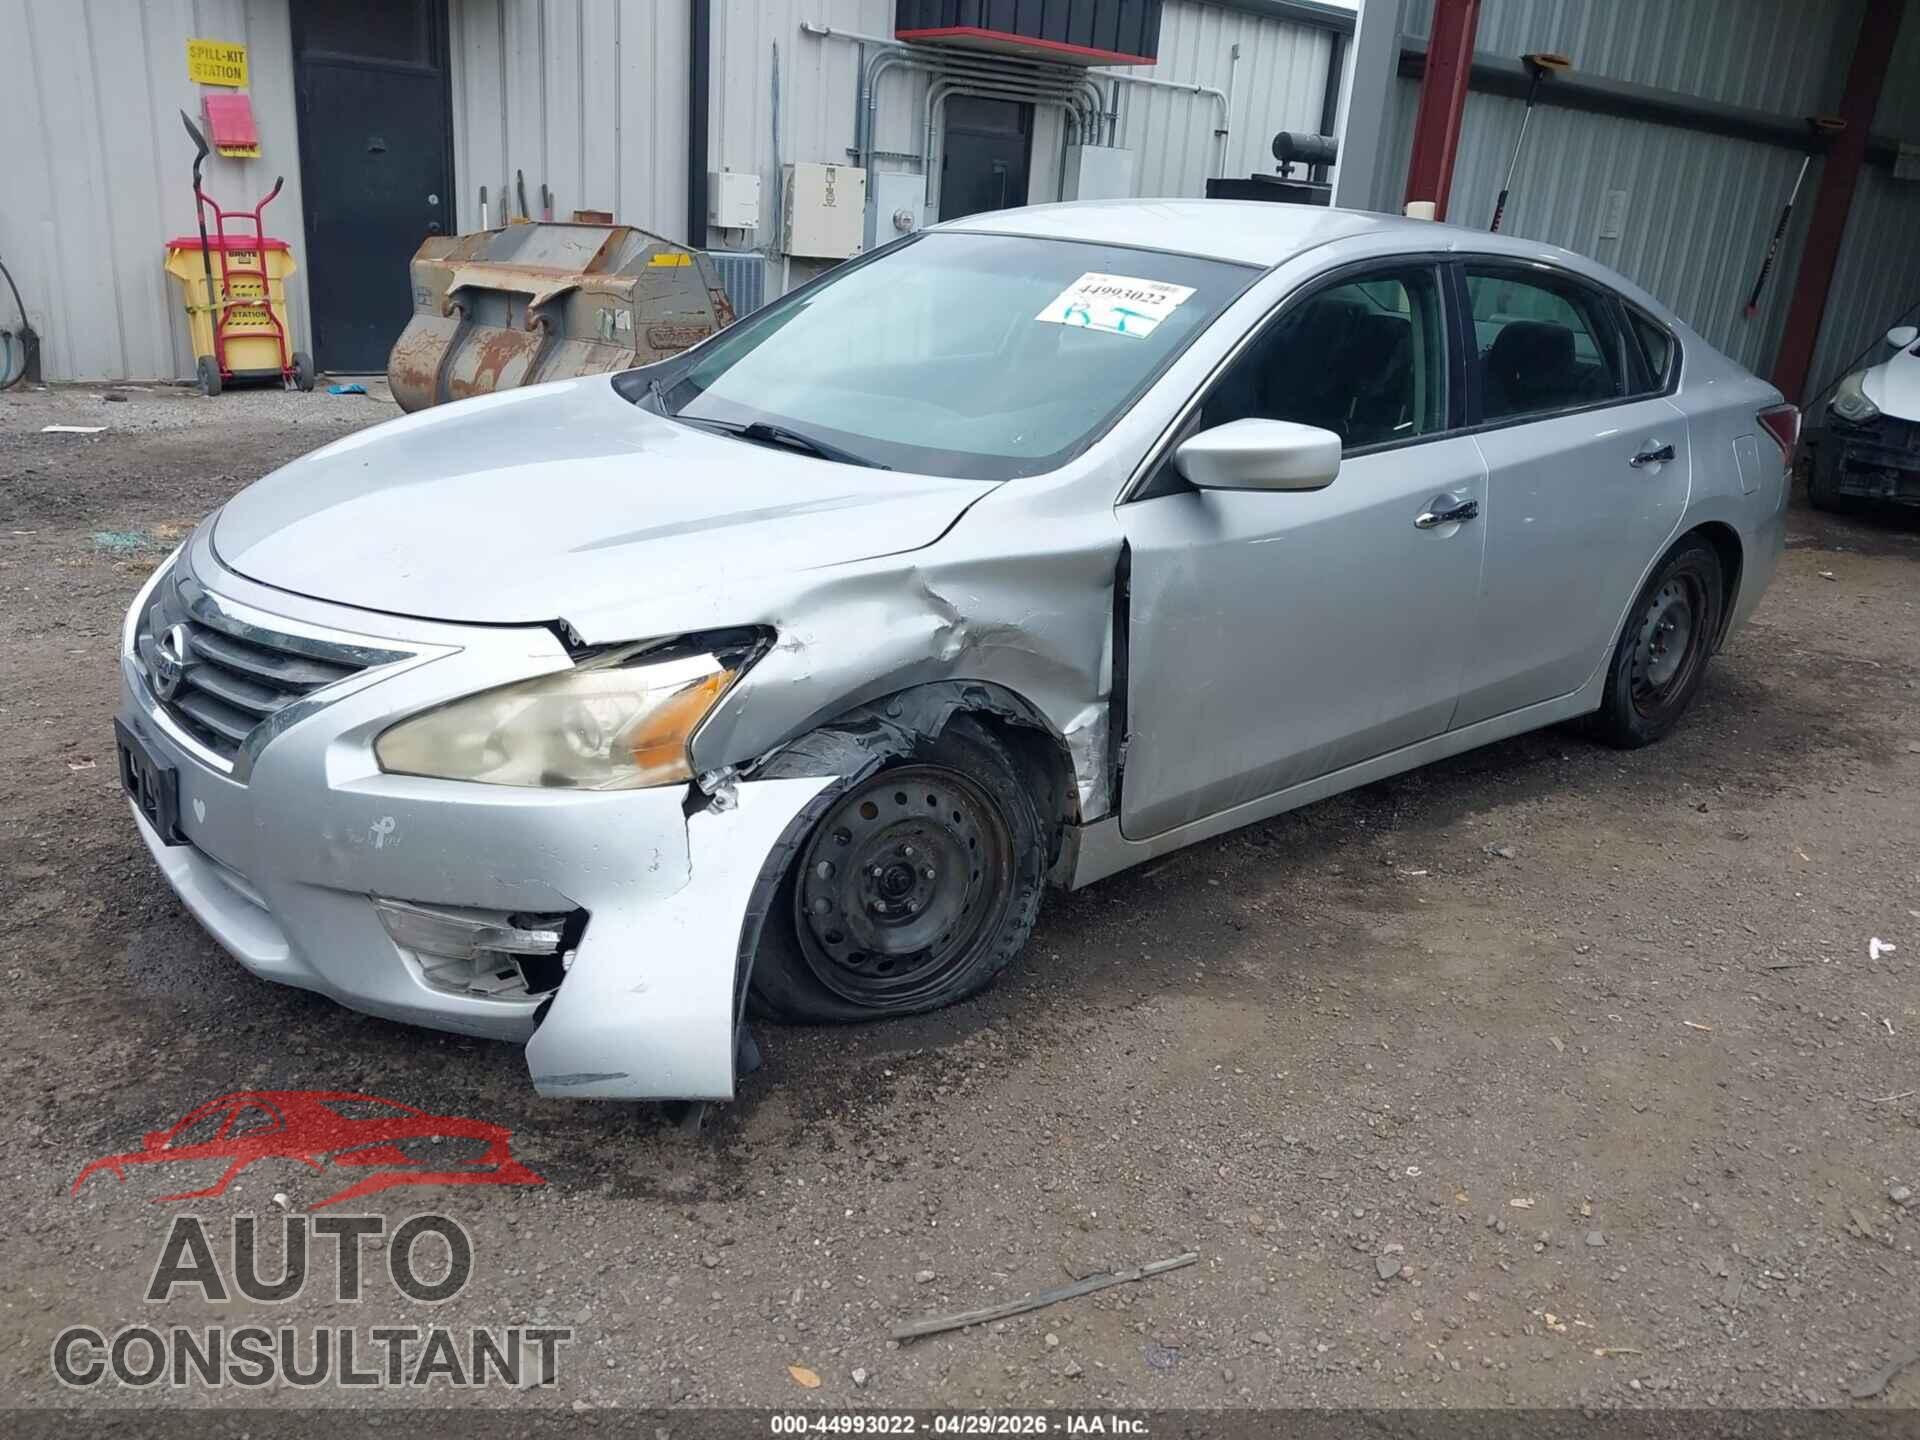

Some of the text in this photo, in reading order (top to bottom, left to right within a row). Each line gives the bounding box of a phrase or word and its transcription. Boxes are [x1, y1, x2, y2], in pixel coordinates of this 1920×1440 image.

[190, 46, 244, 63] SPILL-KIT
[194, 64, 241, 80] STATION
[1079, 284, 1166, 304] 44993022
